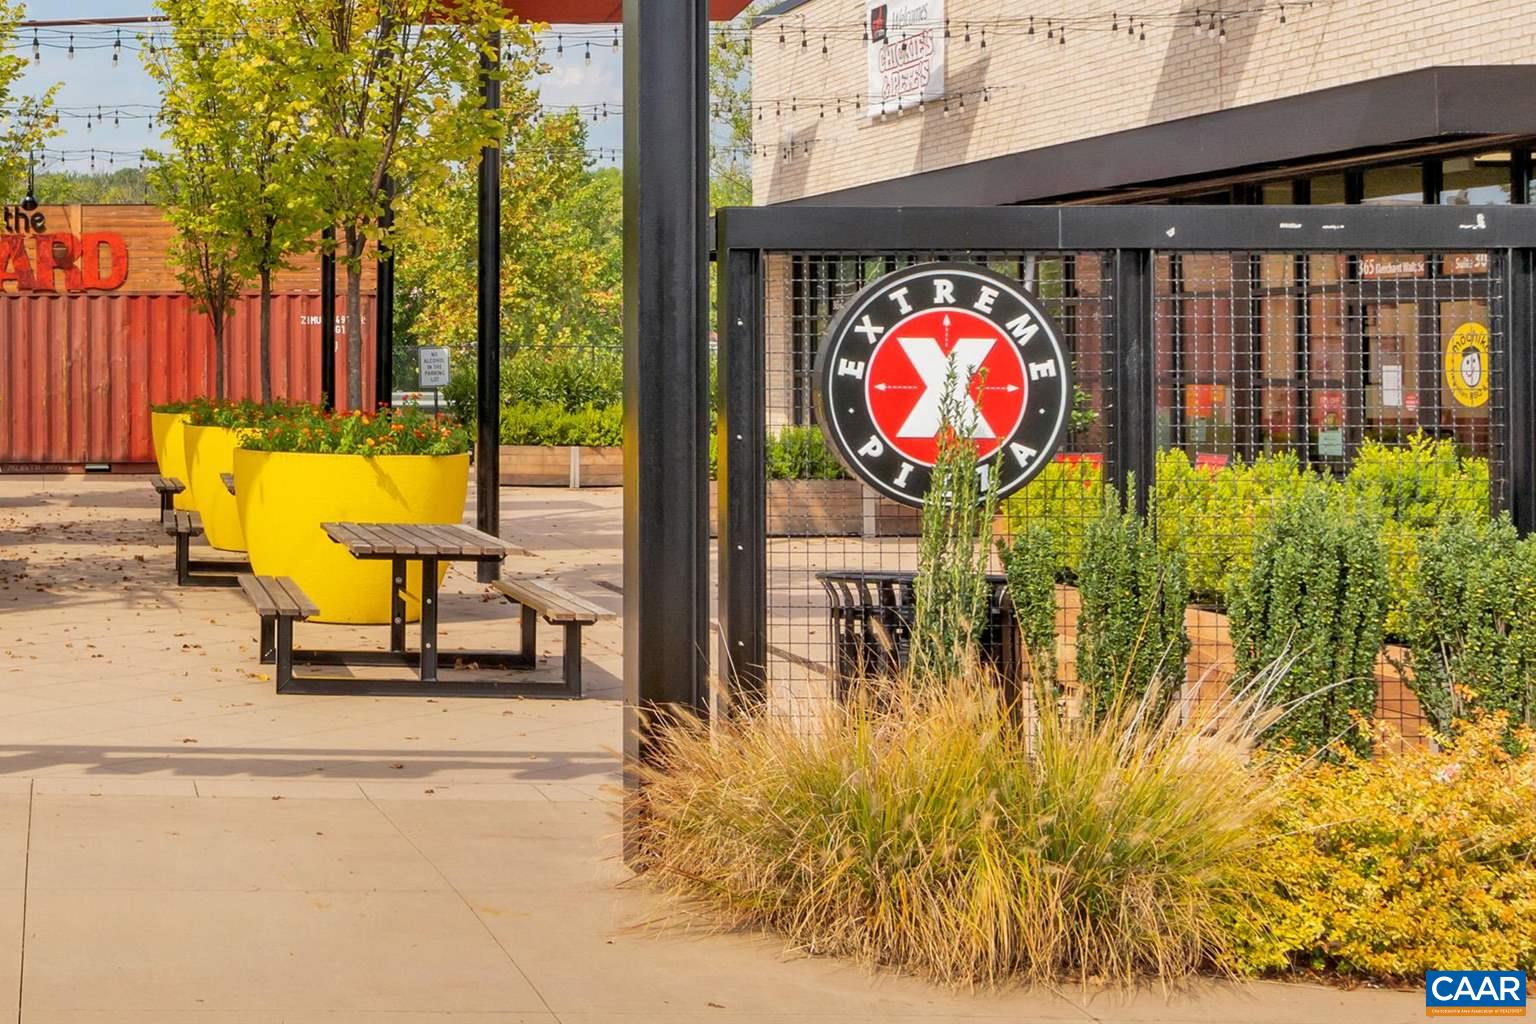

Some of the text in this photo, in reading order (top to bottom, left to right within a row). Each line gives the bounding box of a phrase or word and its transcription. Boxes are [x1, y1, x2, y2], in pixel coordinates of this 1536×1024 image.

[3, 206, 47, 234] the
[300, 315, 322, 325] ZIMU
[838, 279, 1057, 381] EXTREME
[895, 337, 997, 439] X
